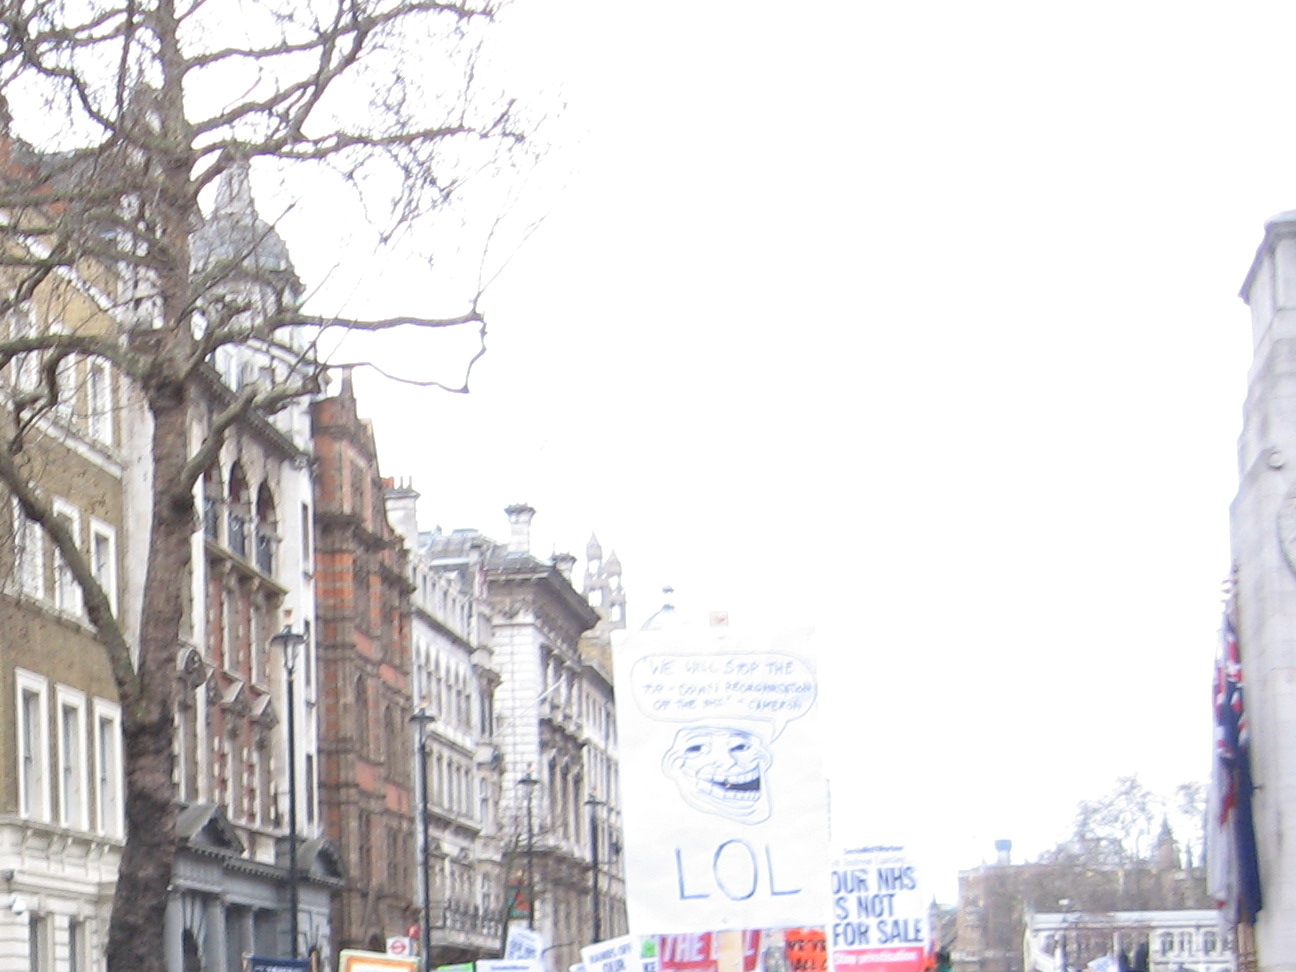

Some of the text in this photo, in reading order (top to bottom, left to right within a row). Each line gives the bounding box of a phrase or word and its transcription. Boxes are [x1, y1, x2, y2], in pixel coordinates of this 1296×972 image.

[724, 659, 759, 674] STOP
[765, 660, 794, 675] THE
[675, 699, 697, 709] THE
[748, 699, 802, 711] CAMERON
[675, 838, 802, 901] LOL
[877, 866, 916, 892] NHS
[856, 893, 896, 919] NOT
[832, 919, 924, 947] FOR SALE
[661, 934, 706, 961] THE
